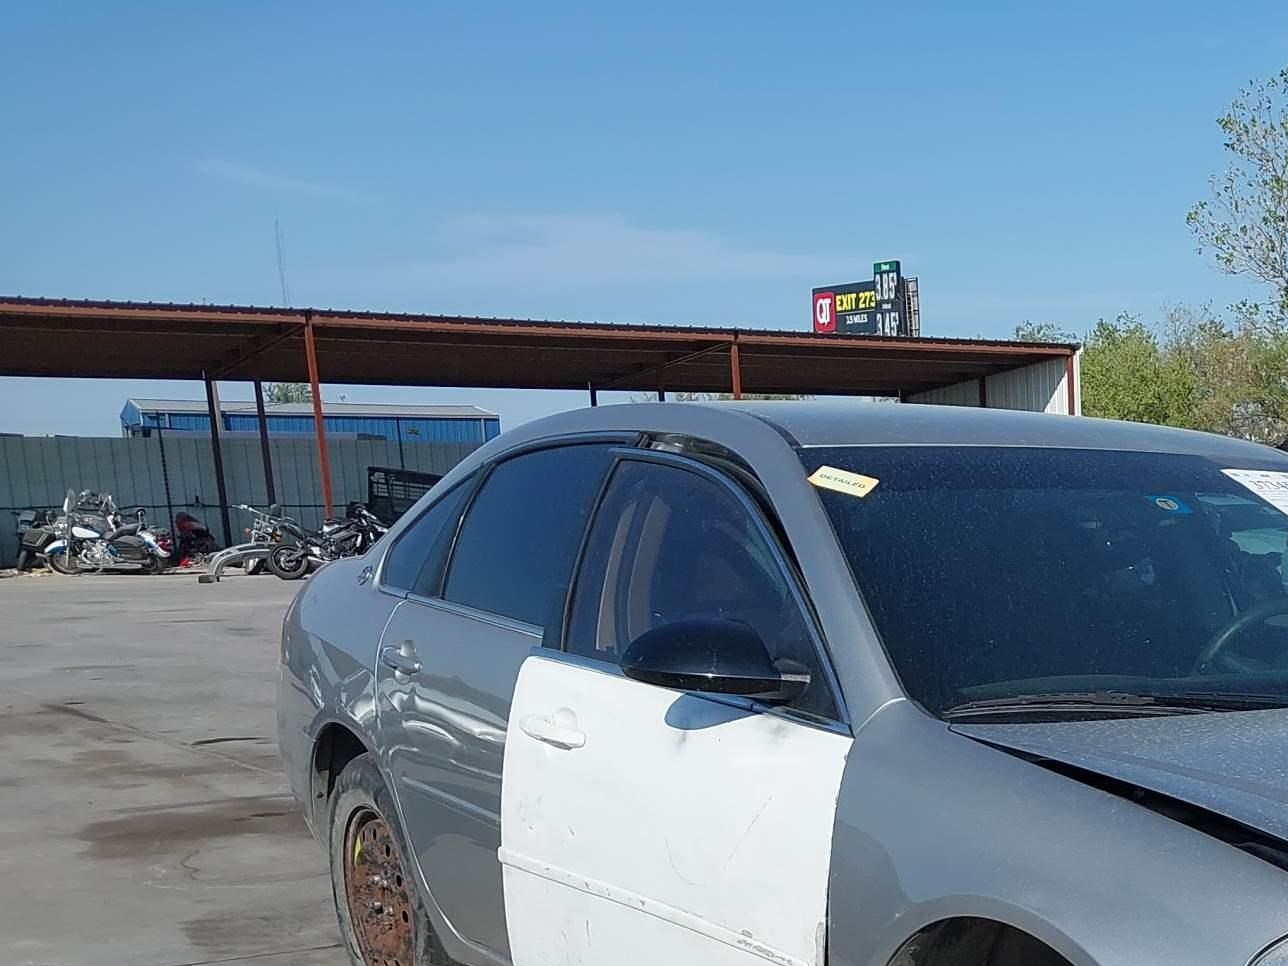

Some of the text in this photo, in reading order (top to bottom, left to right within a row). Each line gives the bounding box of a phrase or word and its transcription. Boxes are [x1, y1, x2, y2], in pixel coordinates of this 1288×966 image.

[836, 290, 876, 312] EXIT 273
[816, 298, 832, 326] QT
[854, 314, 868, 323] MILES
[819, 473, 866, 489] DETAILED
